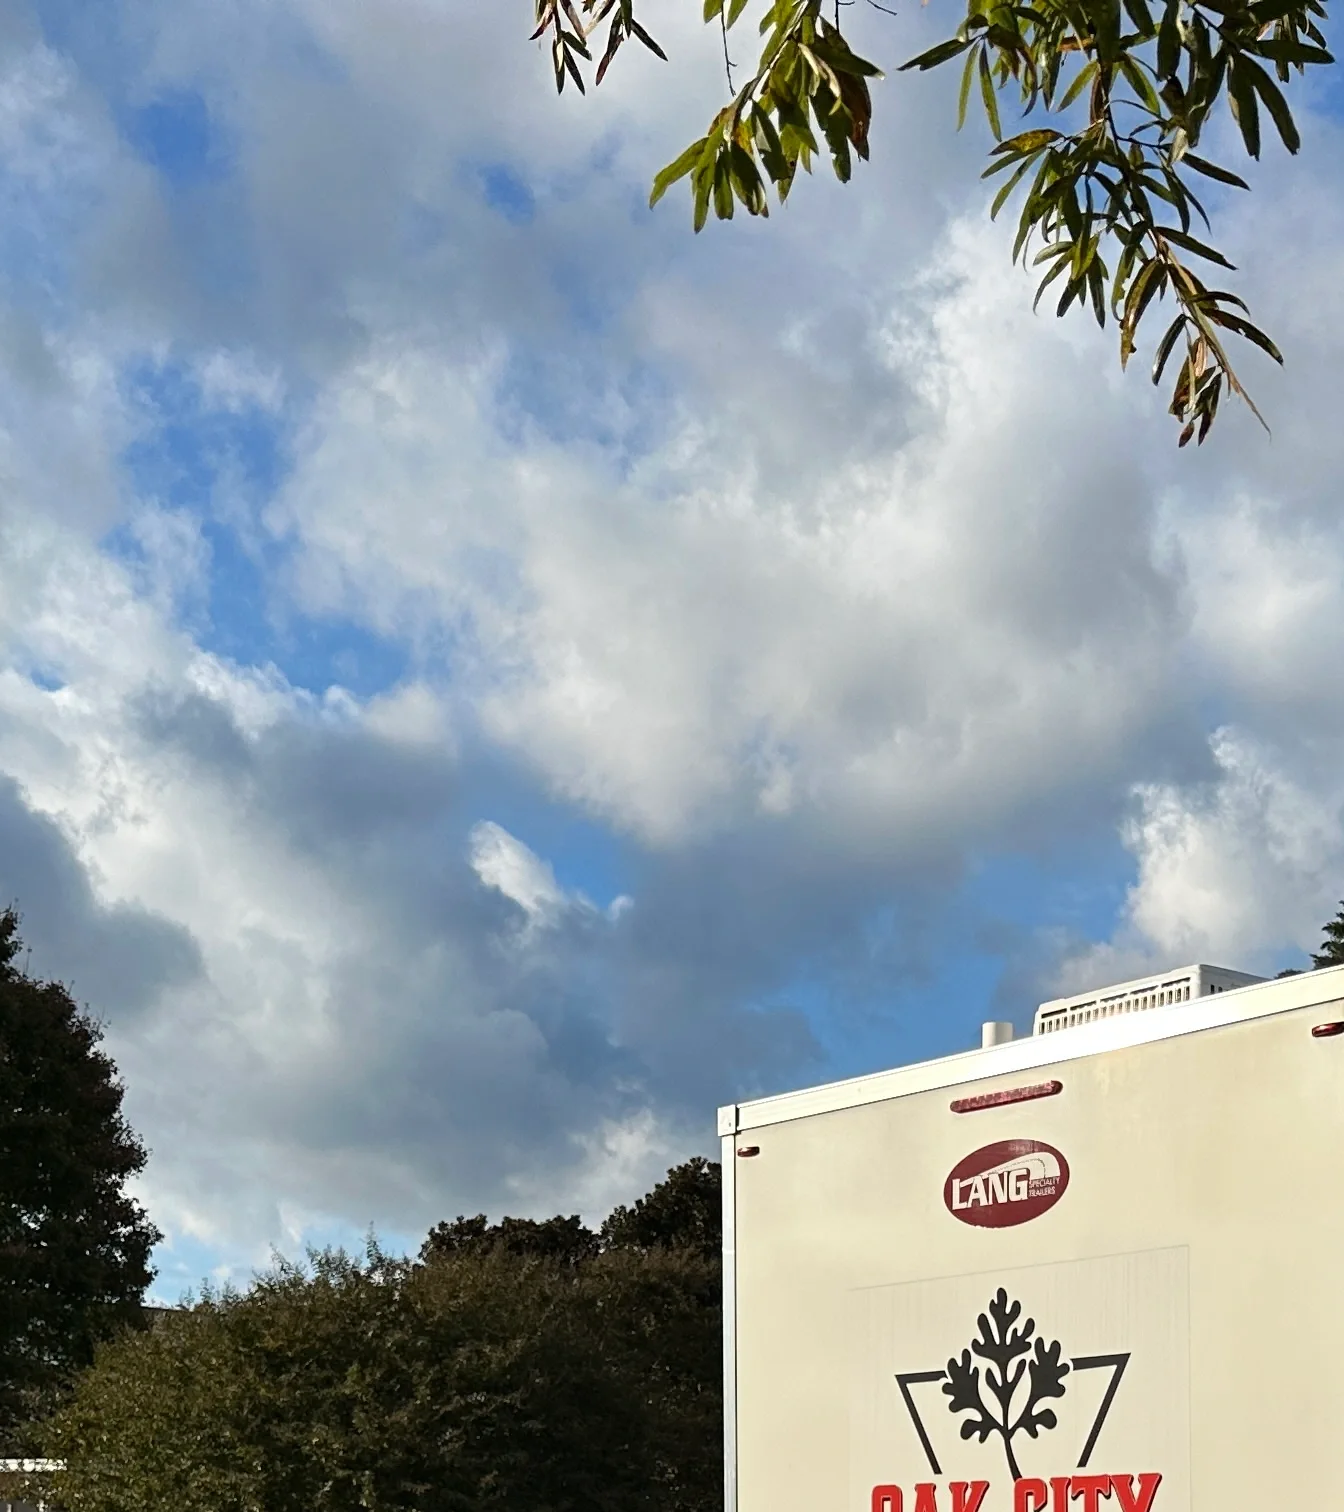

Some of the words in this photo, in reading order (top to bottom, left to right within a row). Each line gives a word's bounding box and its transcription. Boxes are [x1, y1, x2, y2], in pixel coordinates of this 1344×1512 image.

[952, 1167, 1028, 1210] LANG
[1029, 1177, 1060, 1189] SPECIALTY
[1029, 1186, 1056, 1197] TRAILERS
